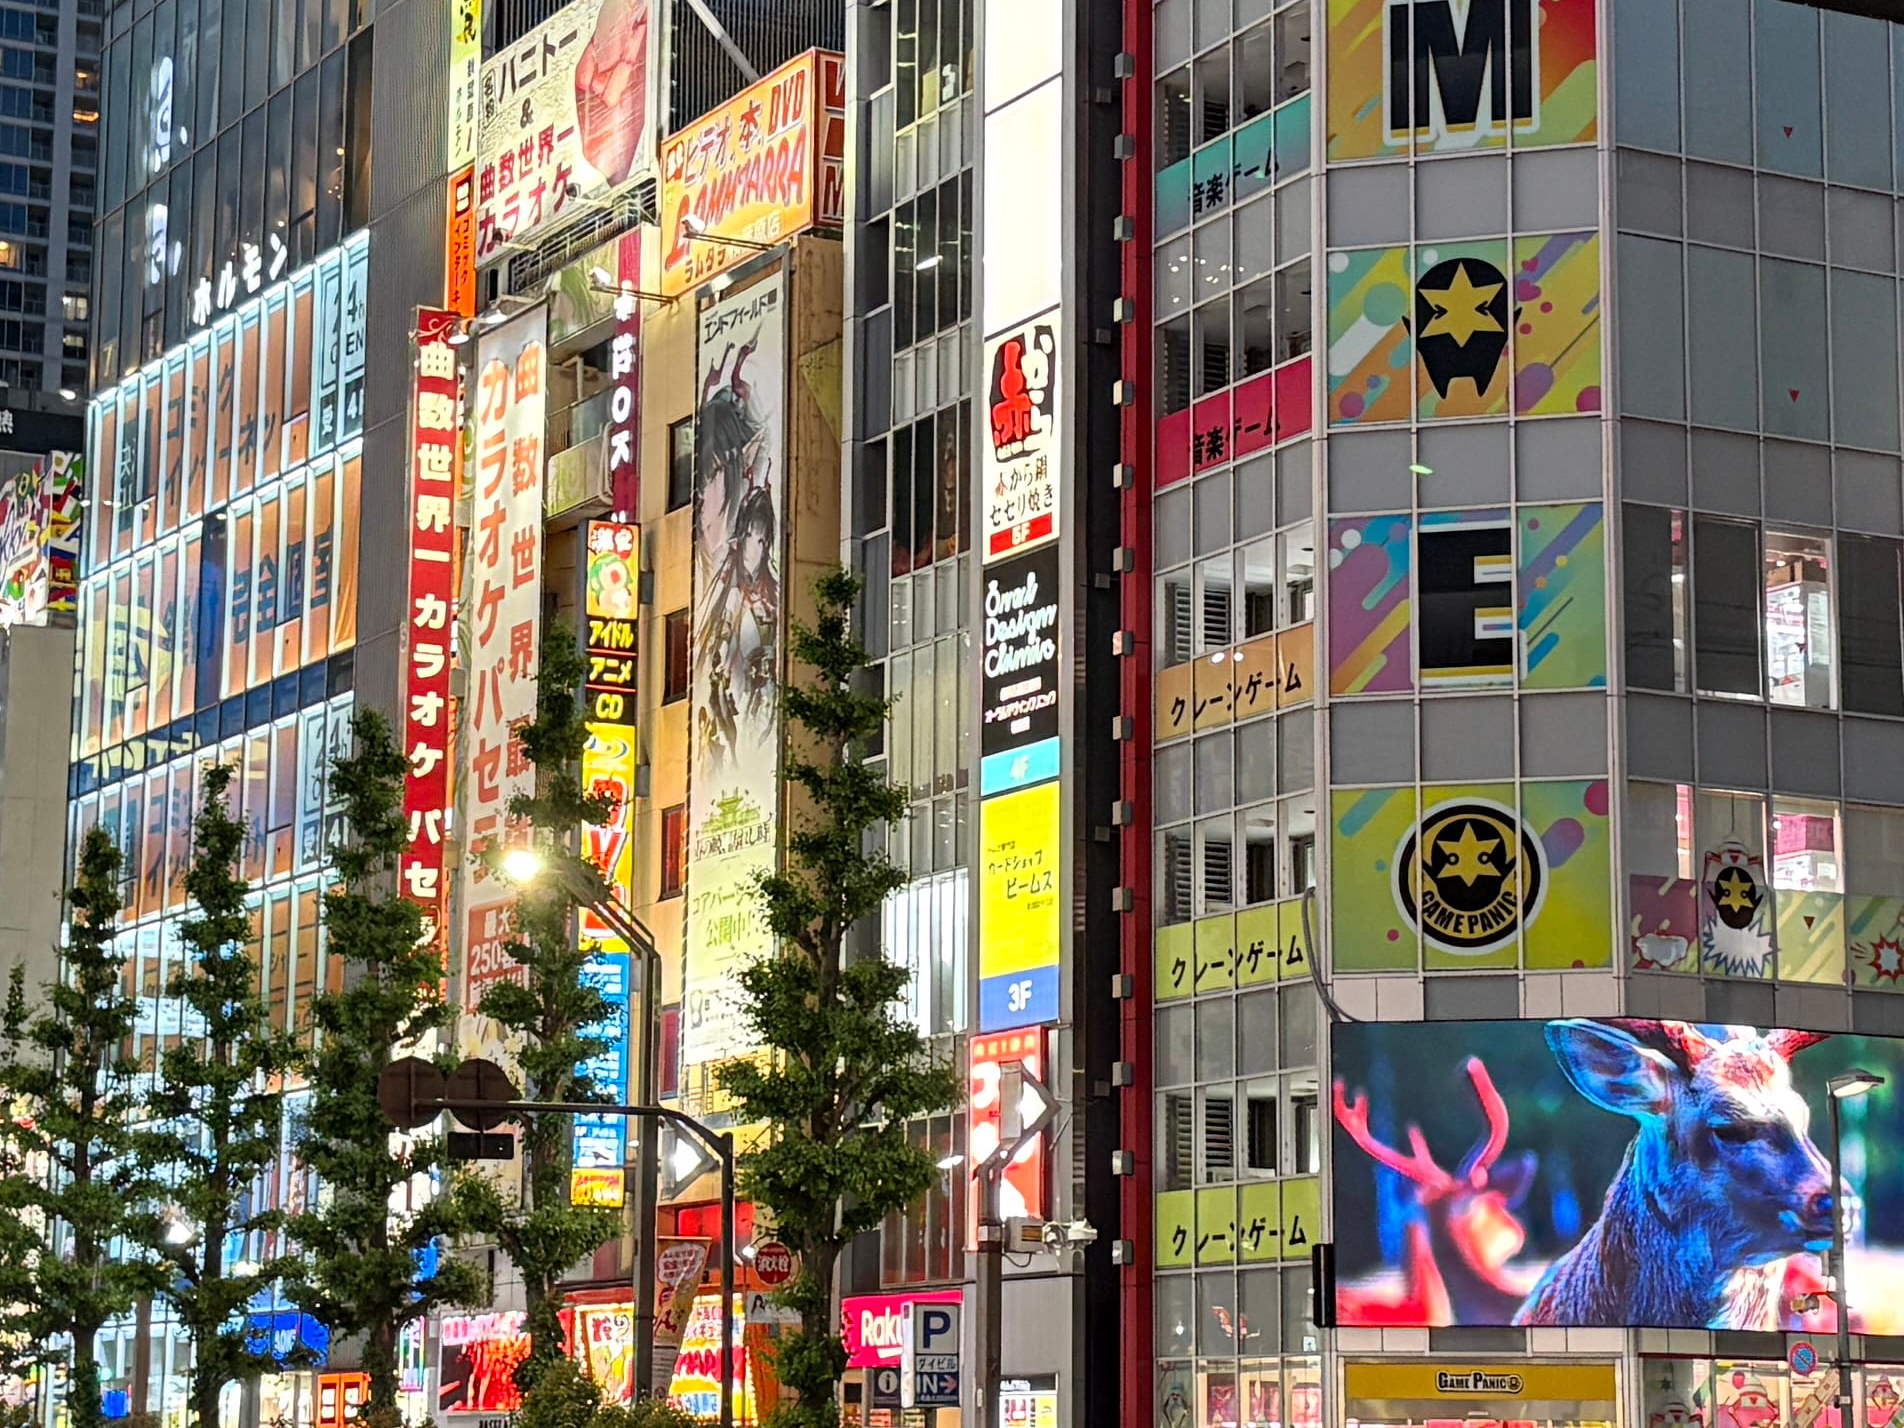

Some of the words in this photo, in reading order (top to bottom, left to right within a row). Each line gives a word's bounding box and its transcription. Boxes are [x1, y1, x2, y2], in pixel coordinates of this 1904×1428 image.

[498, 29, 578, 104] ハニトー
[520, 97, 534, 128] &
[480, 123, 574, 206] 曲数世界一
[478, 162, 573, 257] カラオケ
[193, 232, 288, 326] ホルモン
[413, 342, 455, 561] 曲数世界一
[1417, 527, 1513, 678] E
[588, 620, 634, 649] アイドル
[589, 657, 633, 684] アニメ
[595, 693, 624, 720] CD
[1422, 889, 1464, 933] GAME
[1466, 889, 1518, 935] PANIC
[1008, 979, 1033, 1013] 3F
[923, 1310, 951, 1349] P
[916, 1374, 938, 1393] IN
